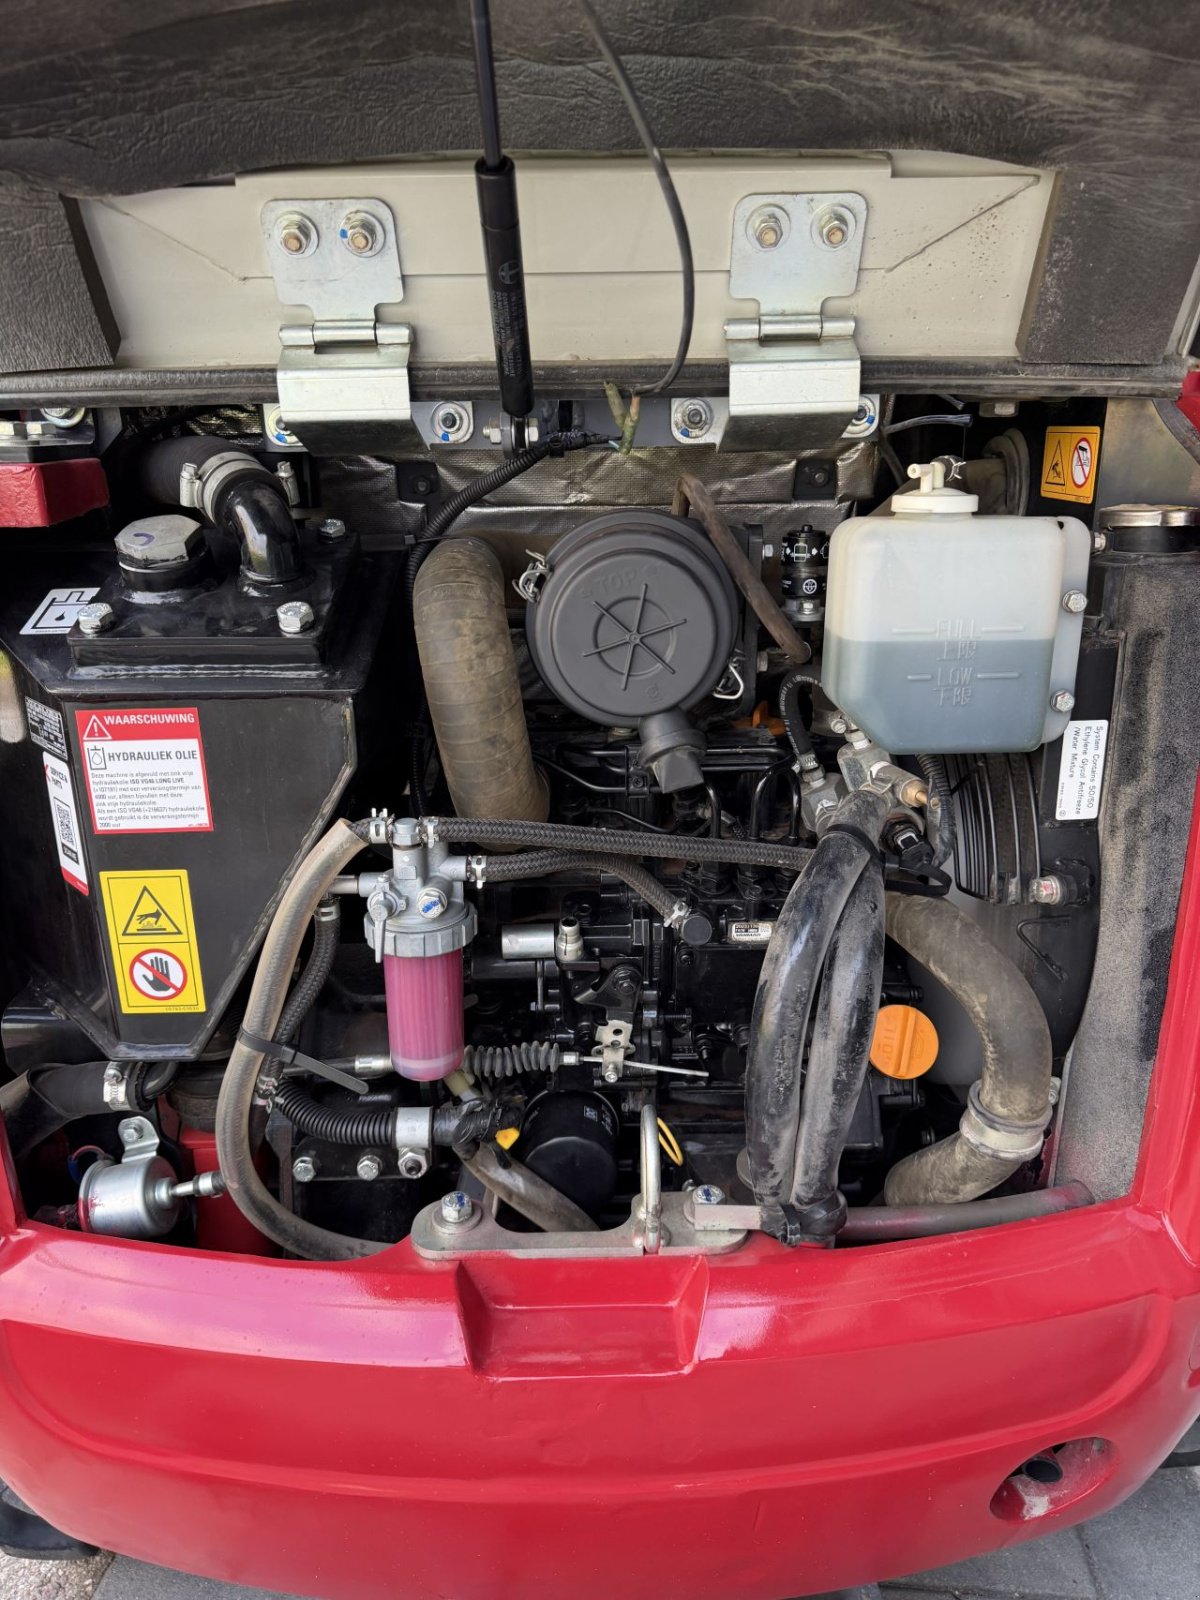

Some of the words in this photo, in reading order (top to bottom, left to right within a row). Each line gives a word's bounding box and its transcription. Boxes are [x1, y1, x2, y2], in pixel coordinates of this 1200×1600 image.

[936, 619, 979, 639] FULL
[937, 666, 973, 687] LOW
[104, 713, 195, 725] WAARSCHUWING
[1072, 726, 1080, 750] /Water
[1082, 726, 1092, 755] Ethylene
[1094, 726, 1103, 750] System
[108, 751, 173, 761] HYDRAULIEK
[175, 750, 198, 760] OLIE
[1068, 753, 1078, 778] Mixture
[1079, 758, 1088, 778] Glycol
[1090, 754, 1100, 782] Contains
[1076, 782, 1086, 814] Antifreeze
[1087, 786, 1096, 808] 50/50
